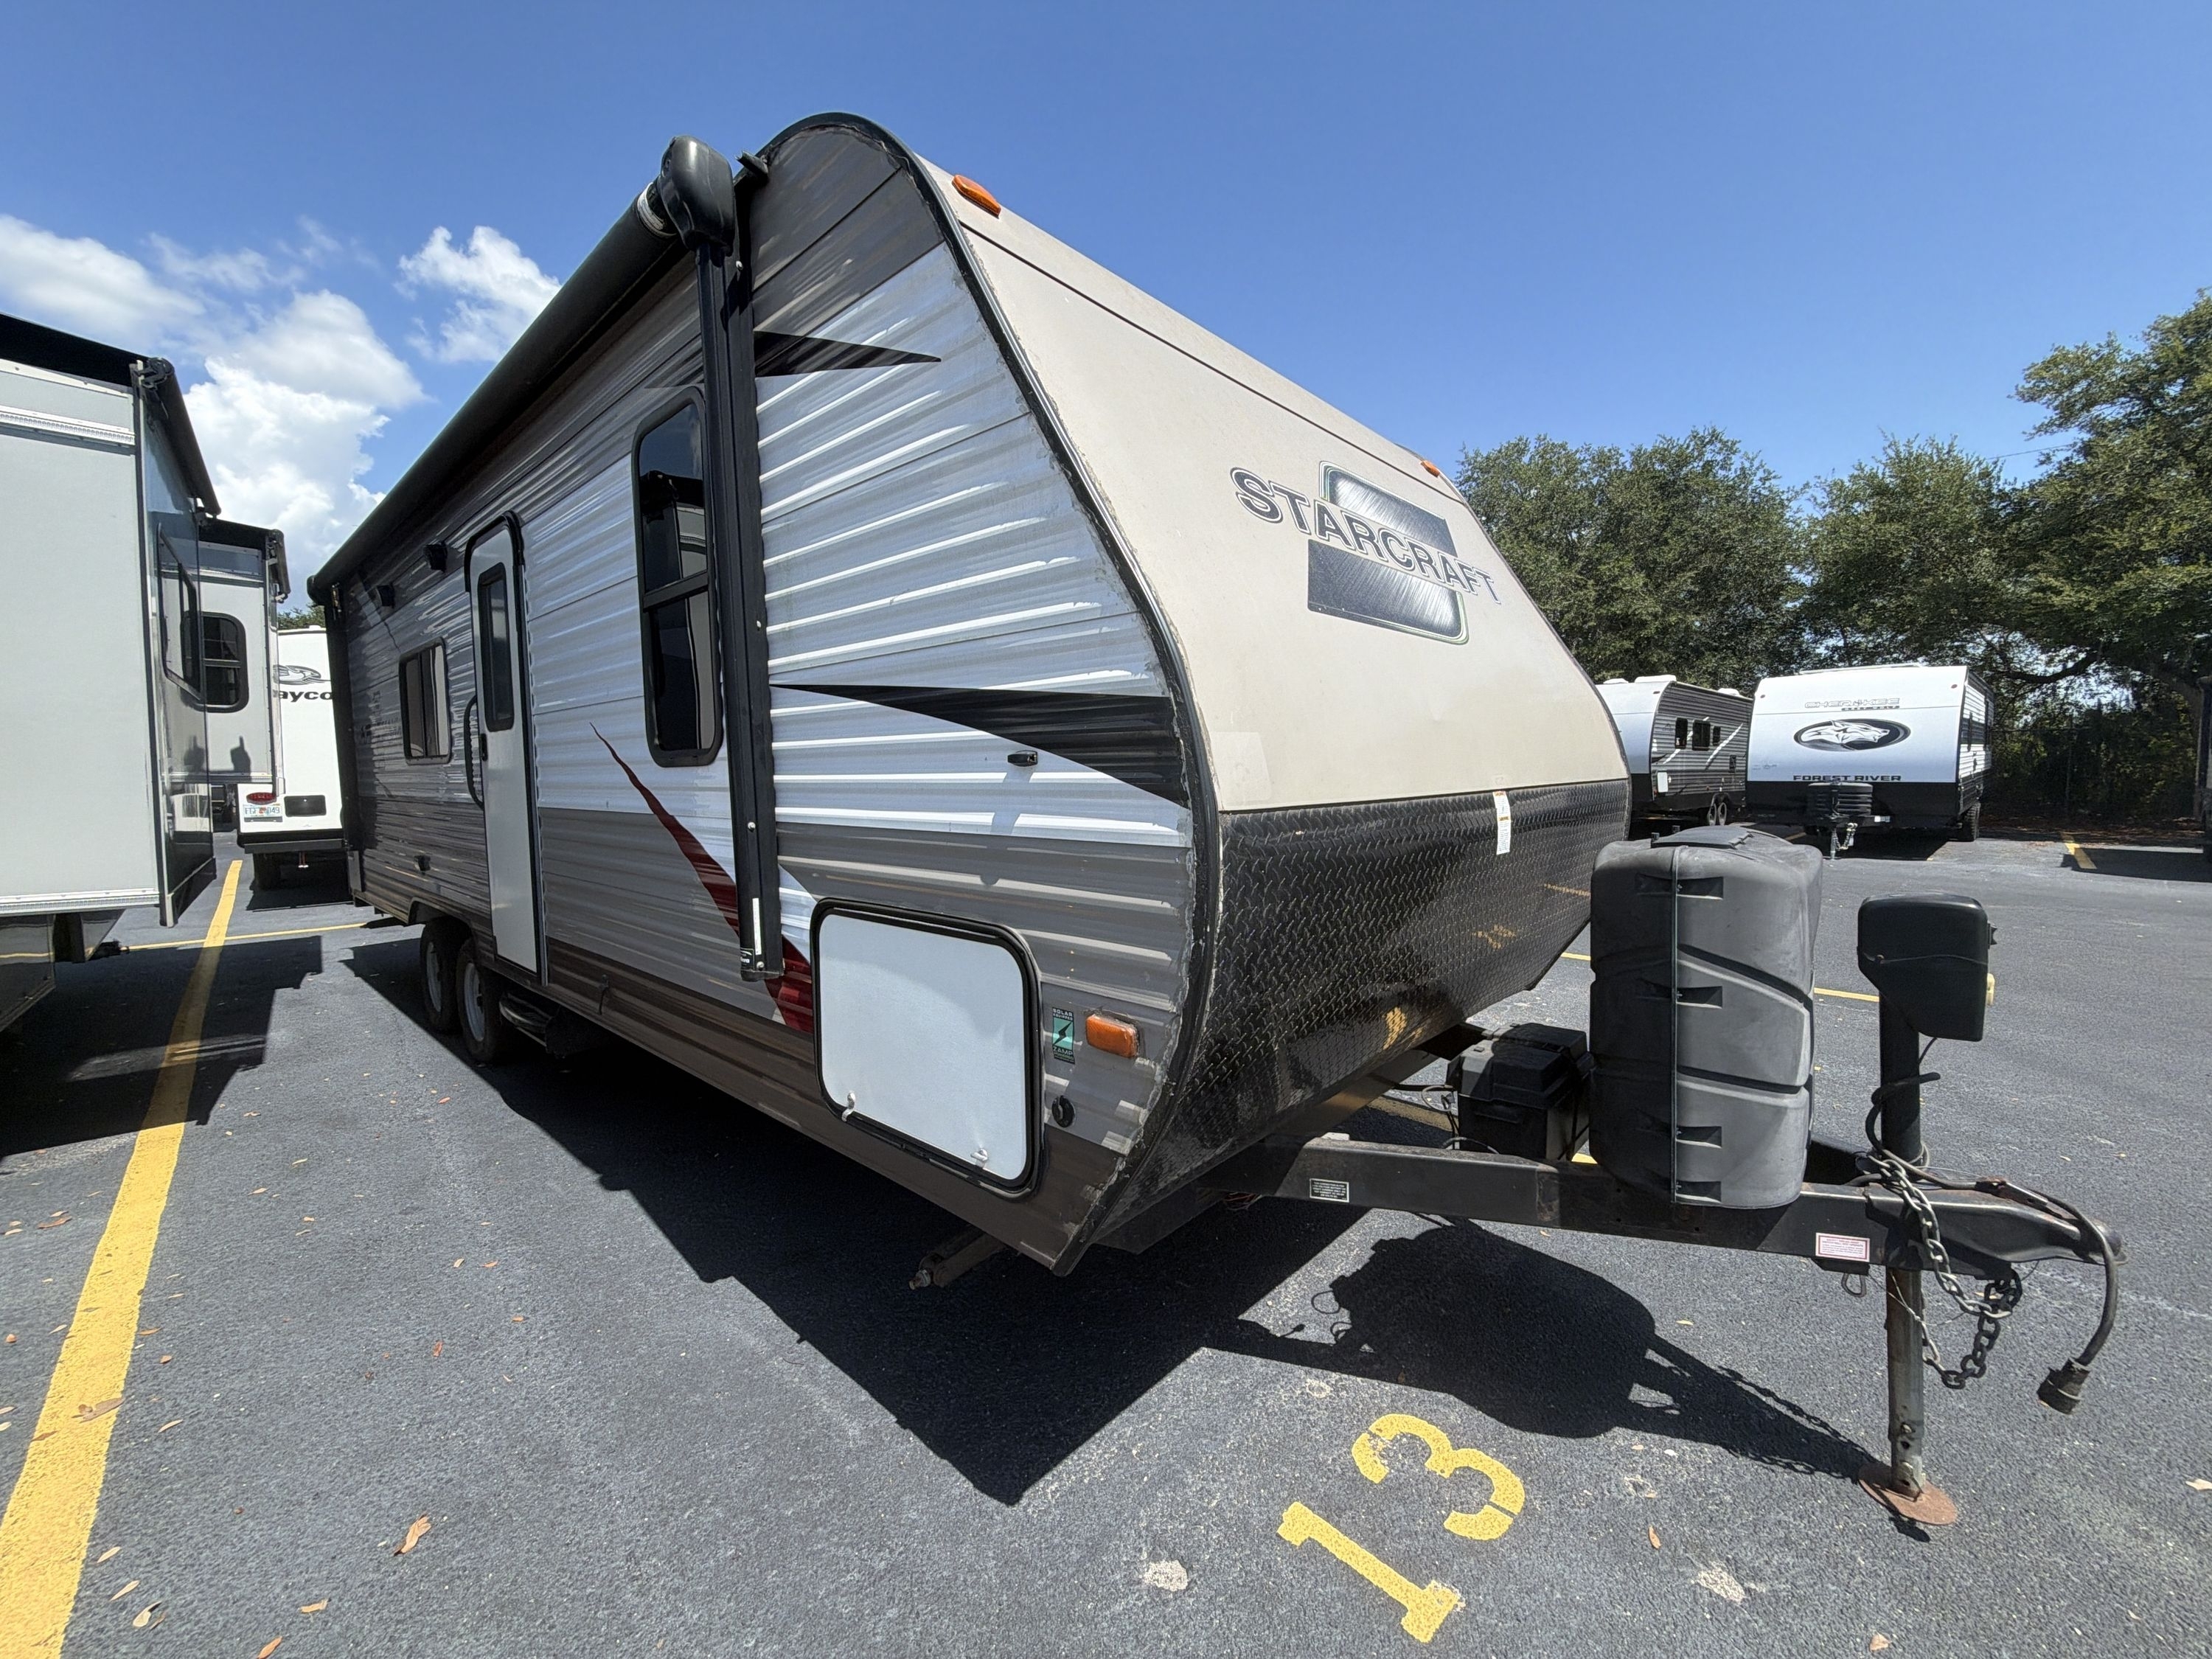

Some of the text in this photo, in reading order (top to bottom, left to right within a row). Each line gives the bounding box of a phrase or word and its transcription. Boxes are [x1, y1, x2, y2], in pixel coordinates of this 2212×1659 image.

[1230, 467, 1501, 604] STARCRAFT
[279, 690, 333, 702] ayco
[1053, 1008, 1073, 1018] SOLAR
[1053, 1047, 1074, 1056] ZAMP
[1277, 1413, 1525, 1643] 13
